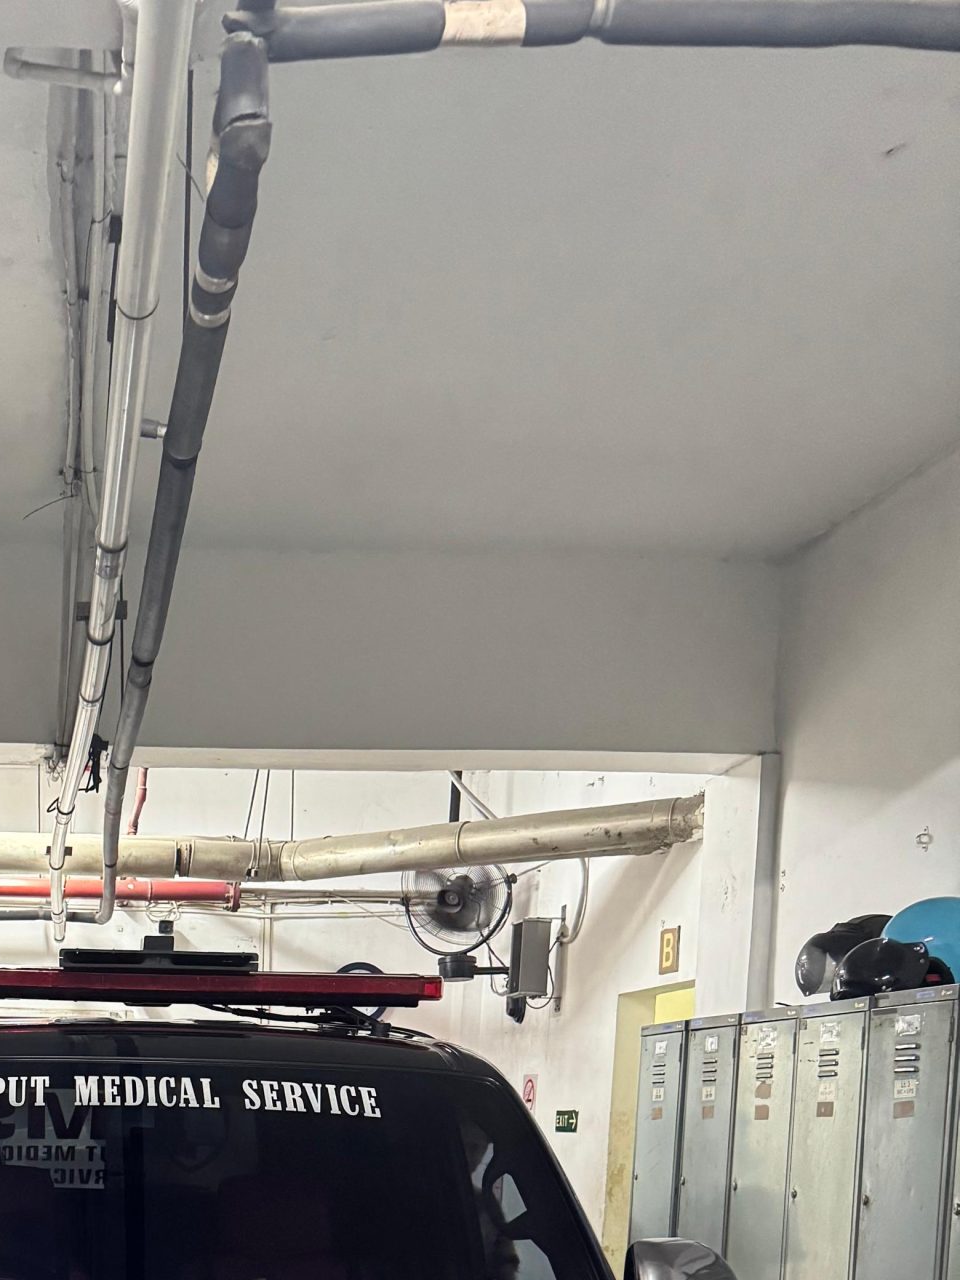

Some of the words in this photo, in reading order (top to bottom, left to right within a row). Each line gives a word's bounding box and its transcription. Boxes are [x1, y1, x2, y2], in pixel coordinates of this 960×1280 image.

[662, 932, 674, 968] B
[74, 1075, 221, 1108] MEDICAL
[242, 1079, 382, 1118] SERVICE
[556, 1115, 568, 1127] EXIT
